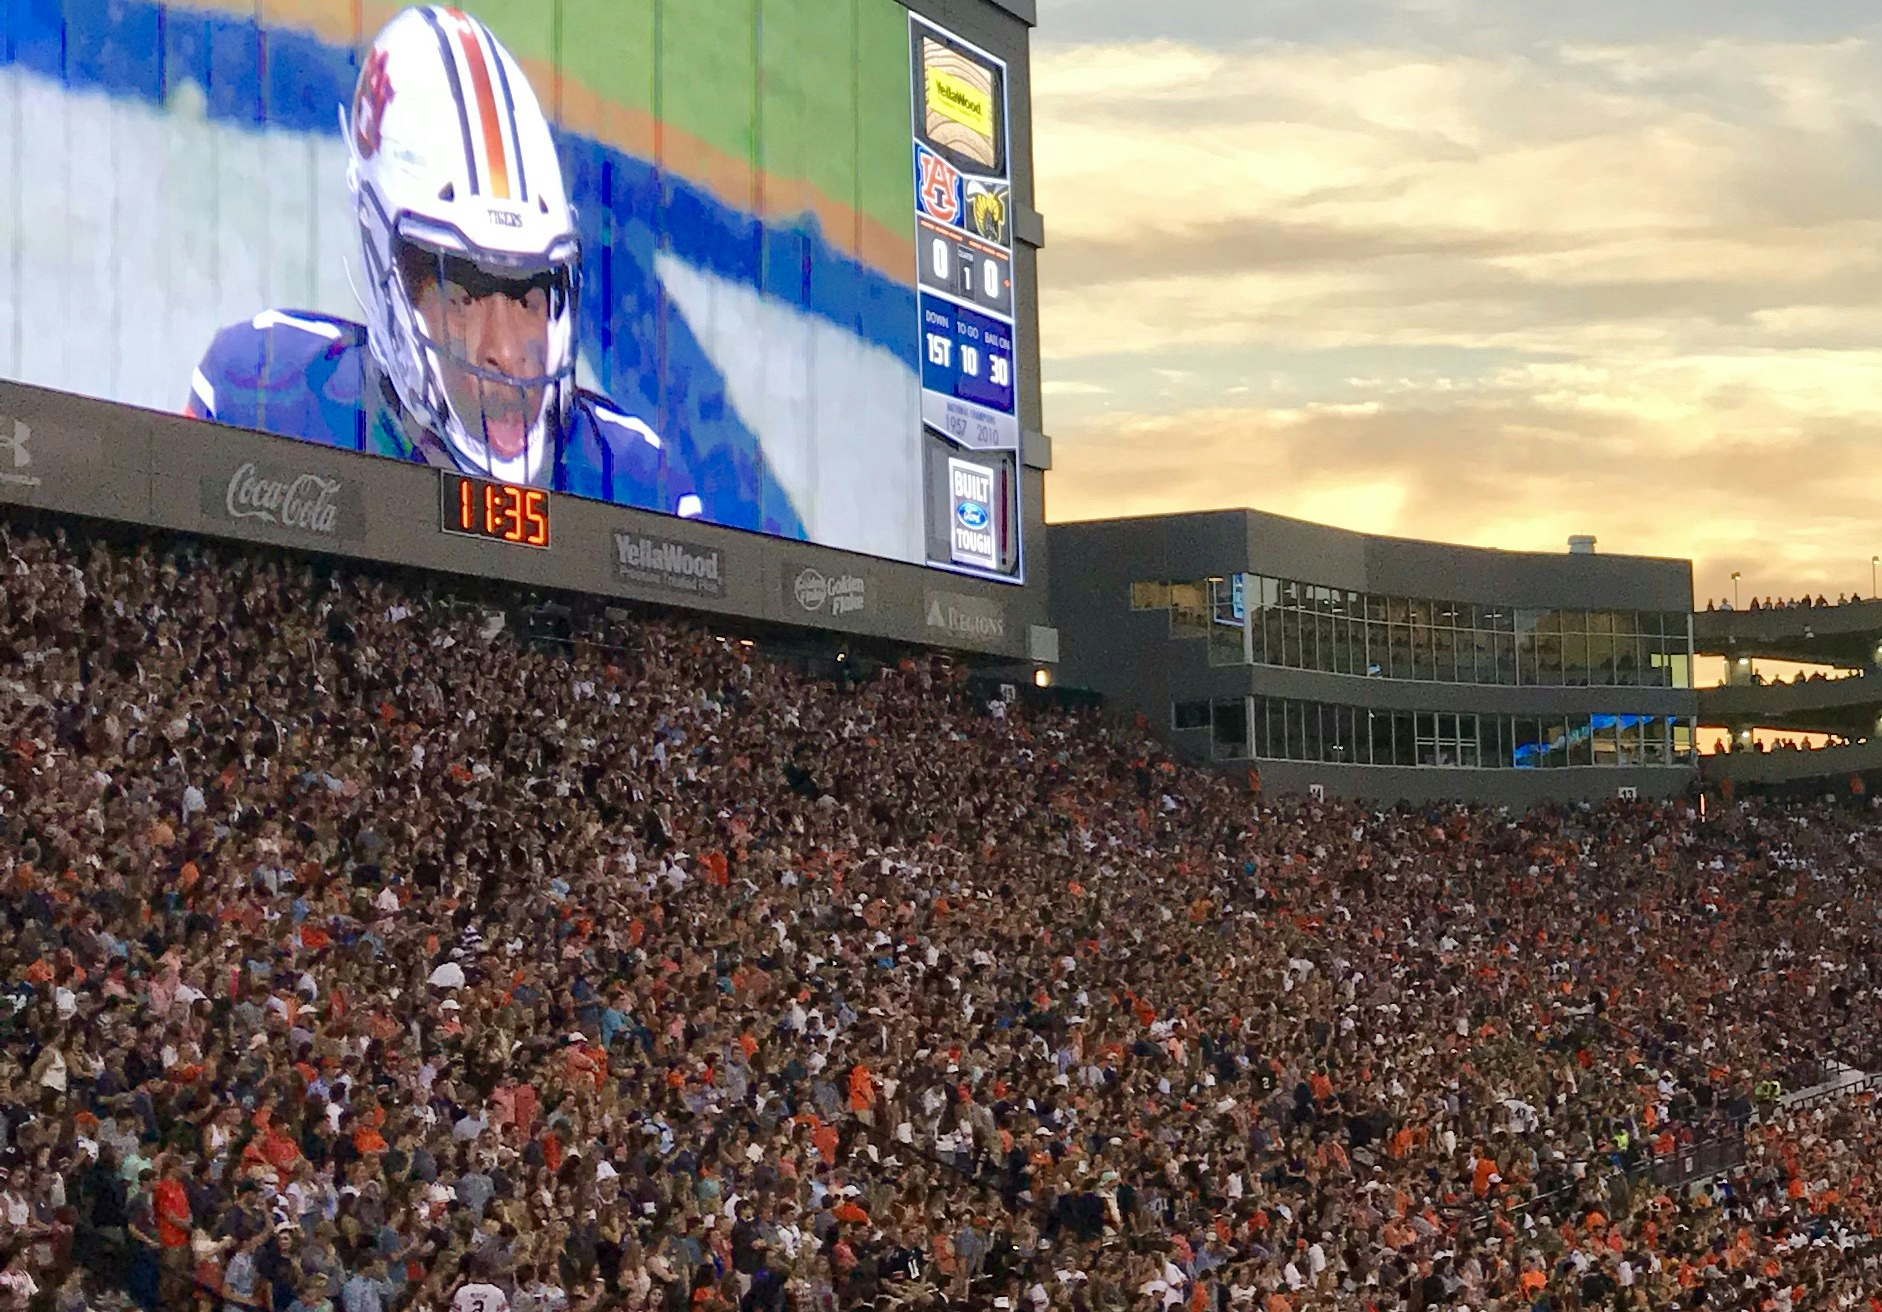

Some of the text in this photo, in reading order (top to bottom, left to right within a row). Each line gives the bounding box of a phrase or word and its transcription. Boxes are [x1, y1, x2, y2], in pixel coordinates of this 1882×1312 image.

[488, 209, 524, 228] TIGERS
[933, 239, 998, 298] 0 1 0
[926, 309, 949, 328] DOWN
[957, 321, 966, 334] TO
[968, 326, 979, 339] GO
[927, 333, 1008, 386] 1ST 10 30
[945, 414, 999, 445] 1957 2010
[226, 463, 341, 532] Coca-Cola
[954, 469, 990, 499] BUILT
[459, 480, 546, 546] 11:35
[614, 533, 719, 578] YellaWood
[956, 530, 991, 556] TOUGH
[827, 574, 865, 597] Golden
[831, 594, 865, 616] Flake
